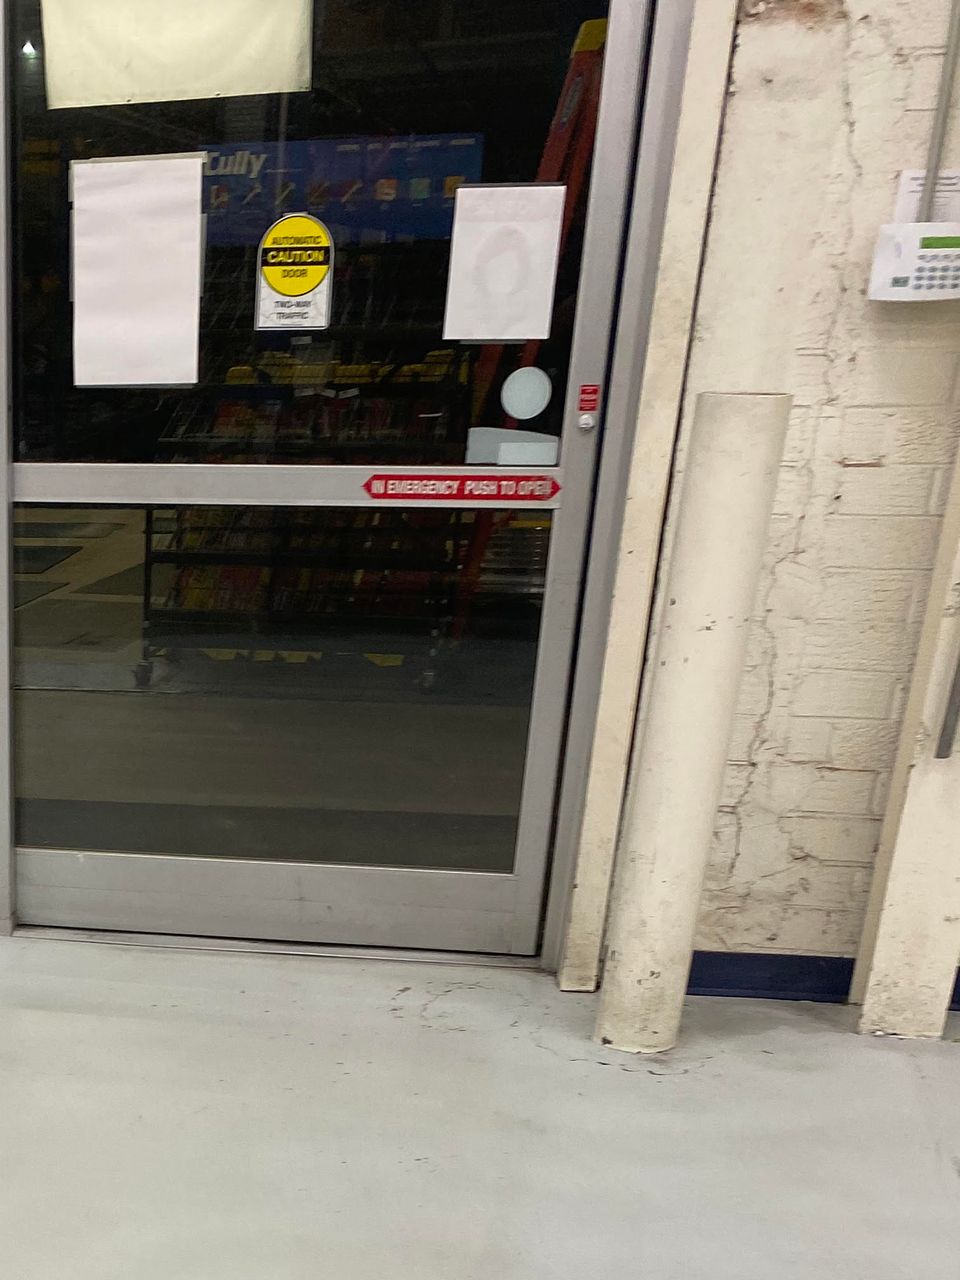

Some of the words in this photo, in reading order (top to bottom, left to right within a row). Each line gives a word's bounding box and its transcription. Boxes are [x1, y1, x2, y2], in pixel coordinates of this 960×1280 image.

[271, 235, 322, 245] AUTOMATIC
[267, 250, 325, 263] CAUTION
[281, 269, 308, 278] DOOR
[276, 311, 309, 320] TRAFFIC
[371, 480, 385, 494] IN
[386, 480, 460, 494] EMERGENCY
[463, 480, 498, 495] PUSH
[499, 481, 517, 495] TO
[517, 481, 553, 495] OPEN
